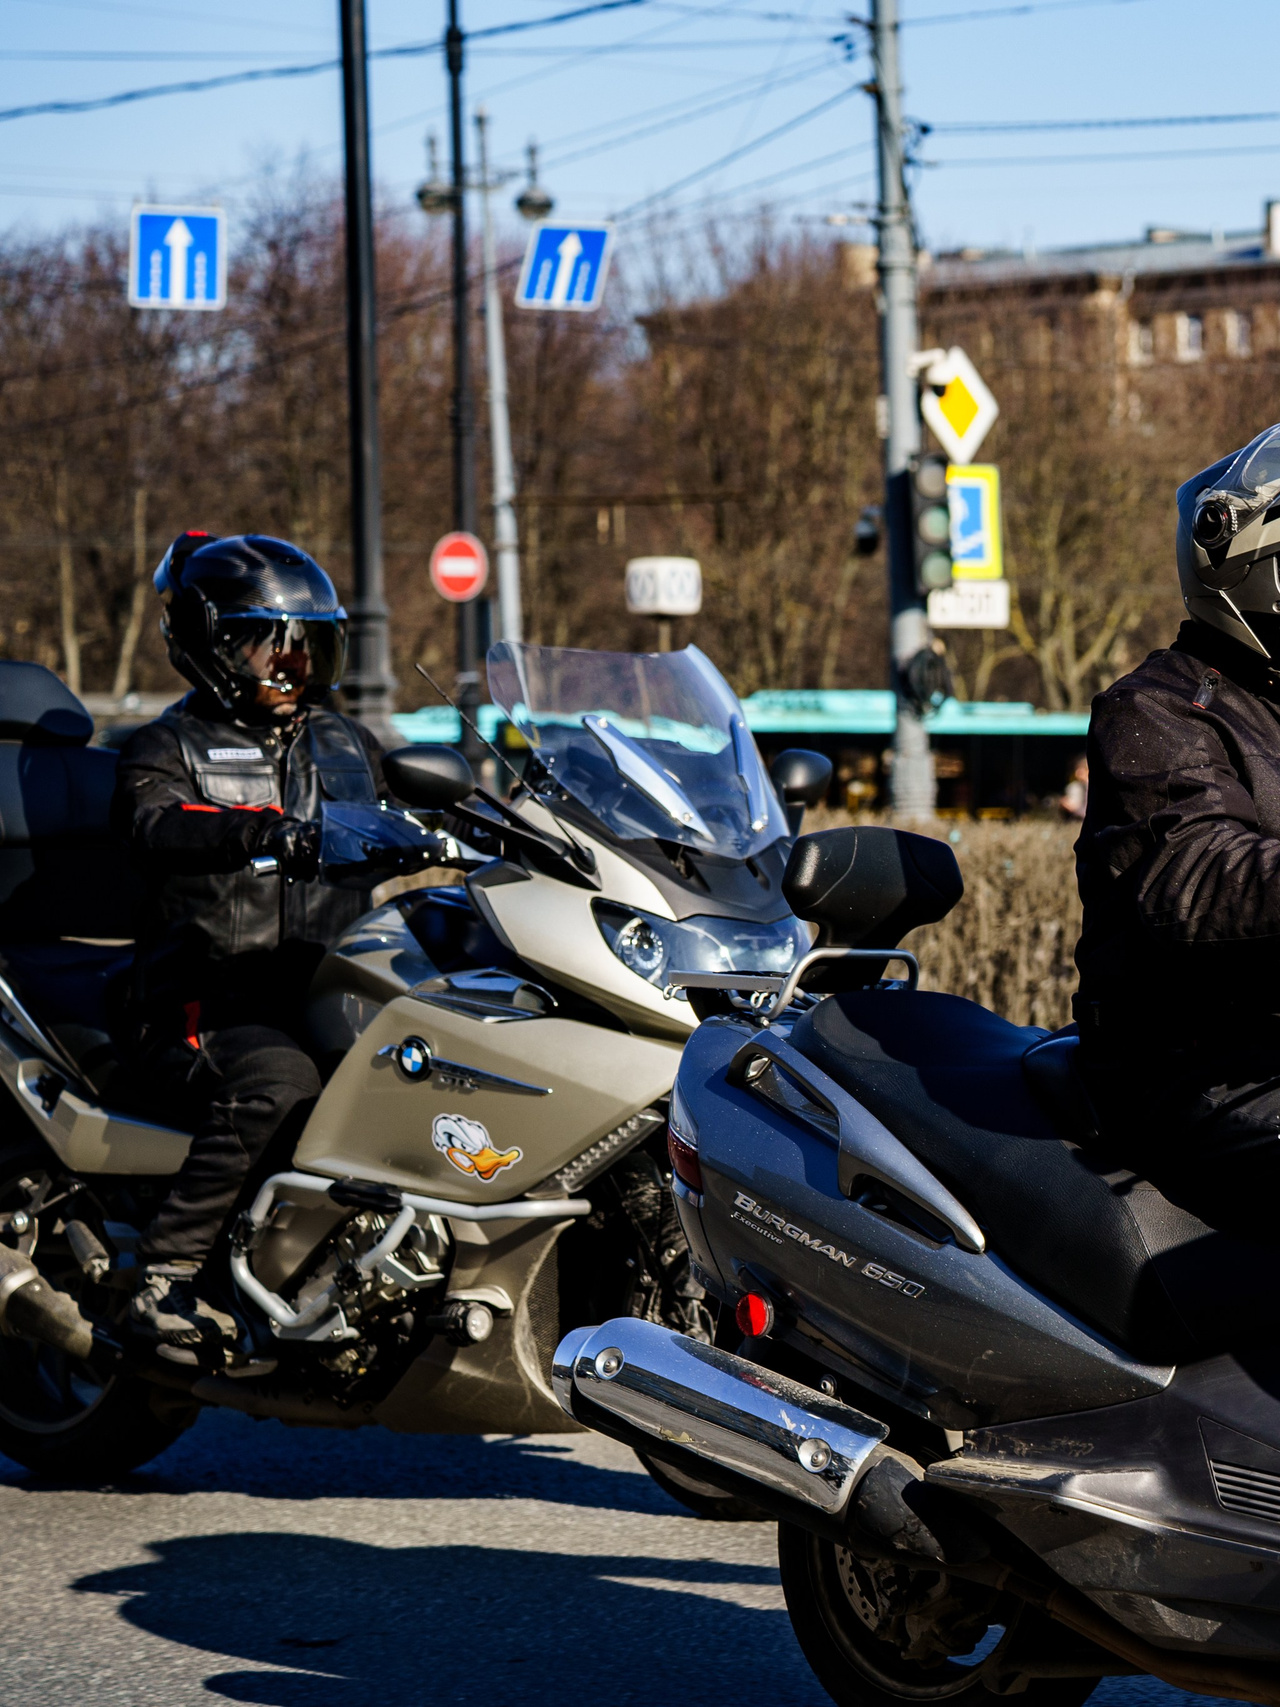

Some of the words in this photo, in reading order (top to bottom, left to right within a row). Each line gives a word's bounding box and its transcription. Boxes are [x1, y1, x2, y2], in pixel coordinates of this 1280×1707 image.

[733, 1211, 784, 1245] Executive
[733, 1190, 857, 1268] BURGMAN
[860, 1262, 926, 1299] 650
